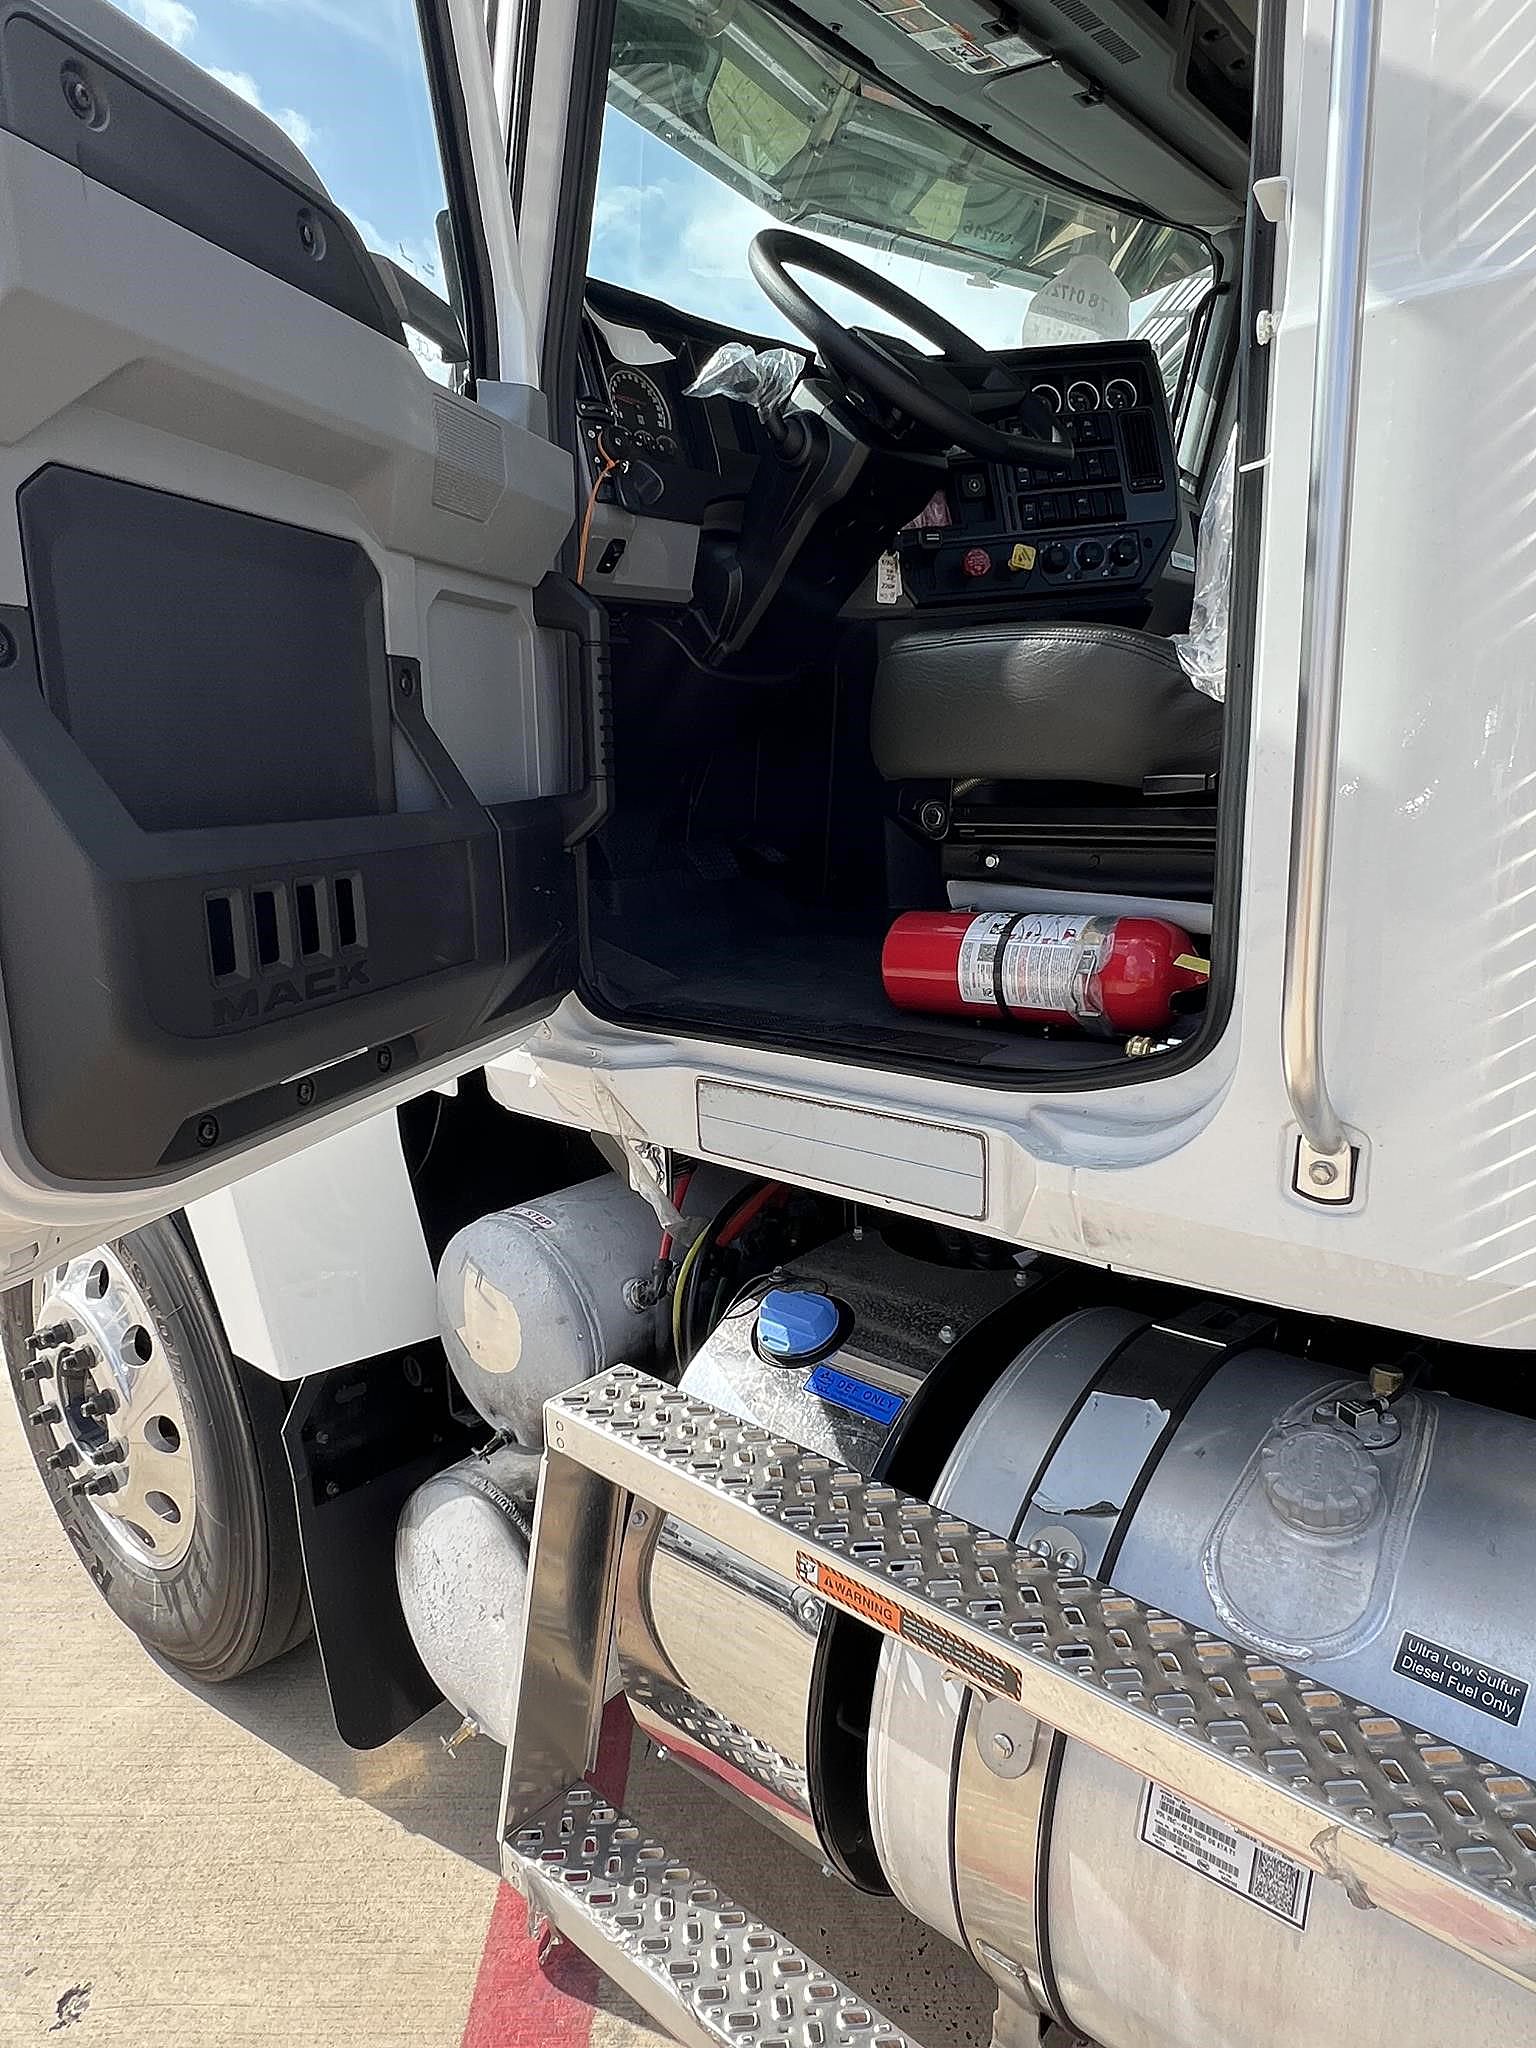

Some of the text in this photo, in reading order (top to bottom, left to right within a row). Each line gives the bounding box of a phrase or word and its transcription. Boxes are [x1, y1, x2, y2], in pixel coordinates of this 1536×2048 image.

[213, 959, 371, 1027] MACK
[524, 1210, 552, 1225] STEP
[836, 1379, 859, 1394] DEF
[862, 1390, 896, 1409] ONLY
[832, 1581, 893, 1622] WARNING
[1401, 1655, 1516, 1718] Diesel Fuel Only
[1408, 1639, 1521, 1698] Ultra Low Sulfur
